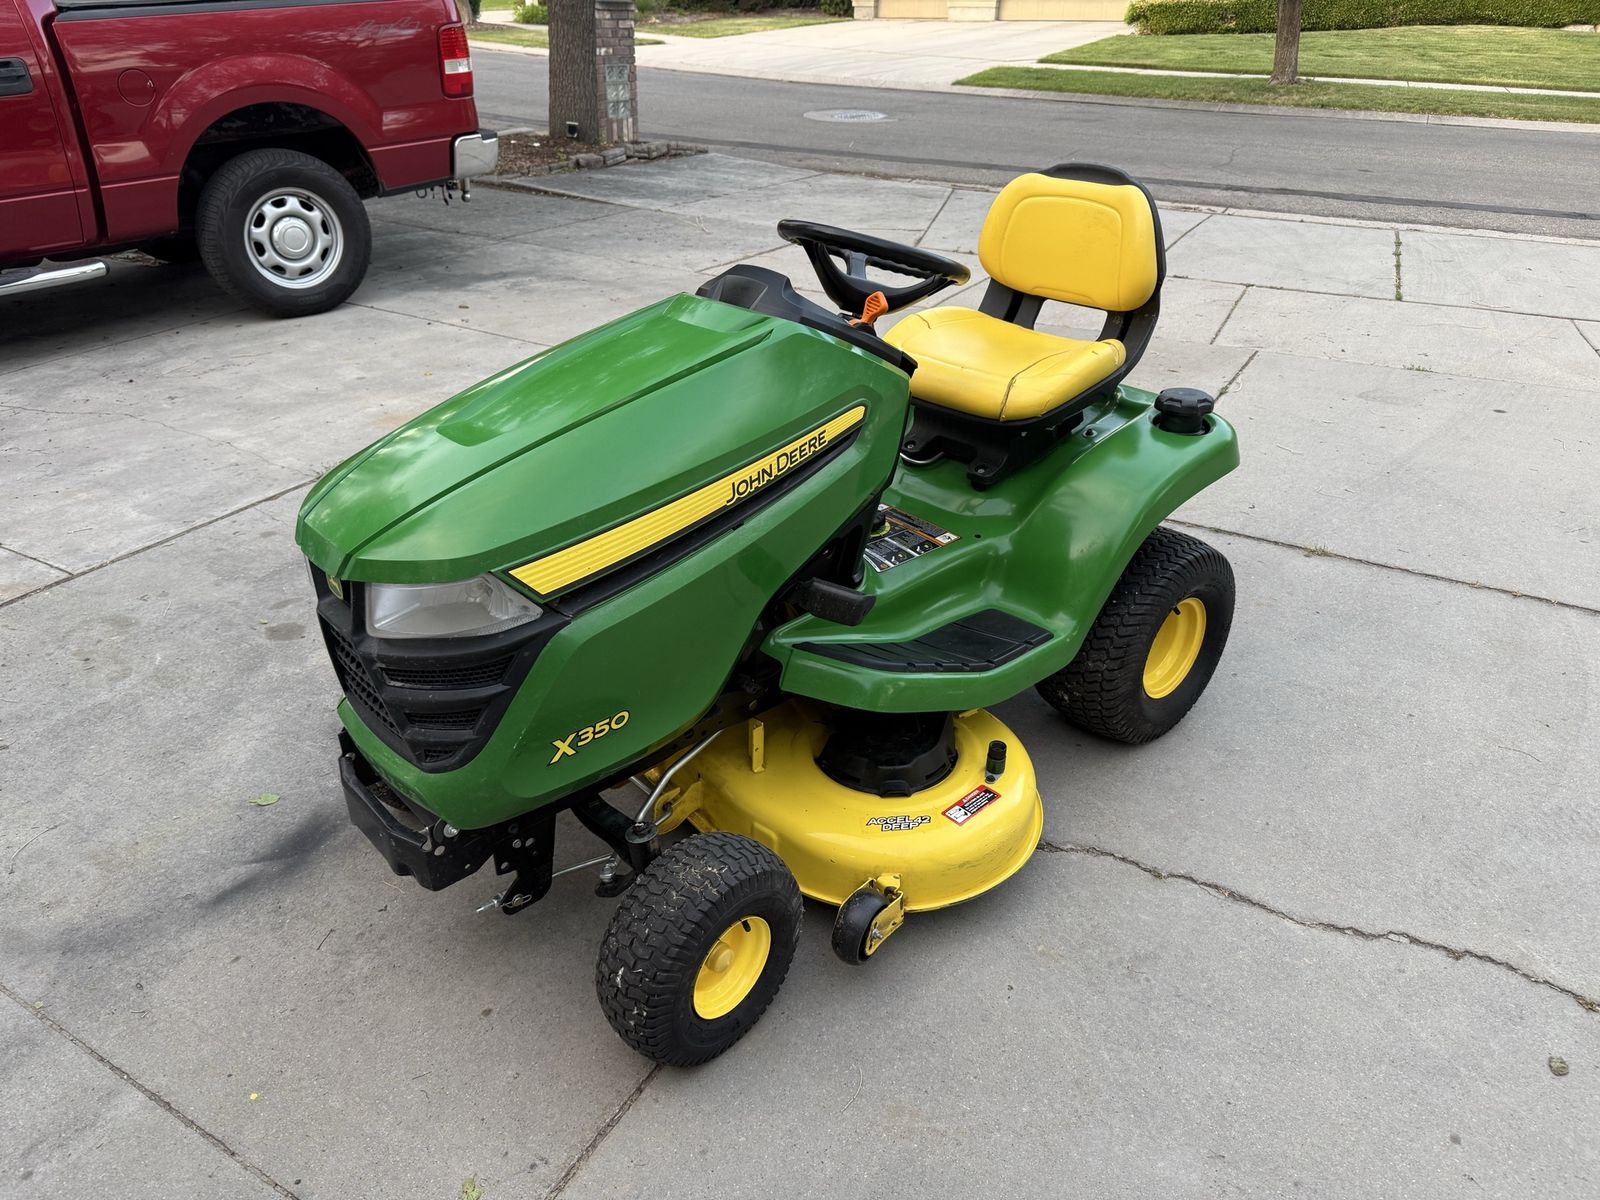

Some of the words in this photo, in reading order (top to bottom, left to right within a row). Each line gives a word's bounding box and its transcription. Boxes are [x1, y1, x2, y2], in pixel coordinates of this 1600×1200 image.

[726, 463, 774, 504] JOHN
[776, 430, 827, 474] DEERE
[548, 710, 630, 767] X350
[866, 815, 913, 825] ACCEL
[881, 822, 919, 831] DEEP
